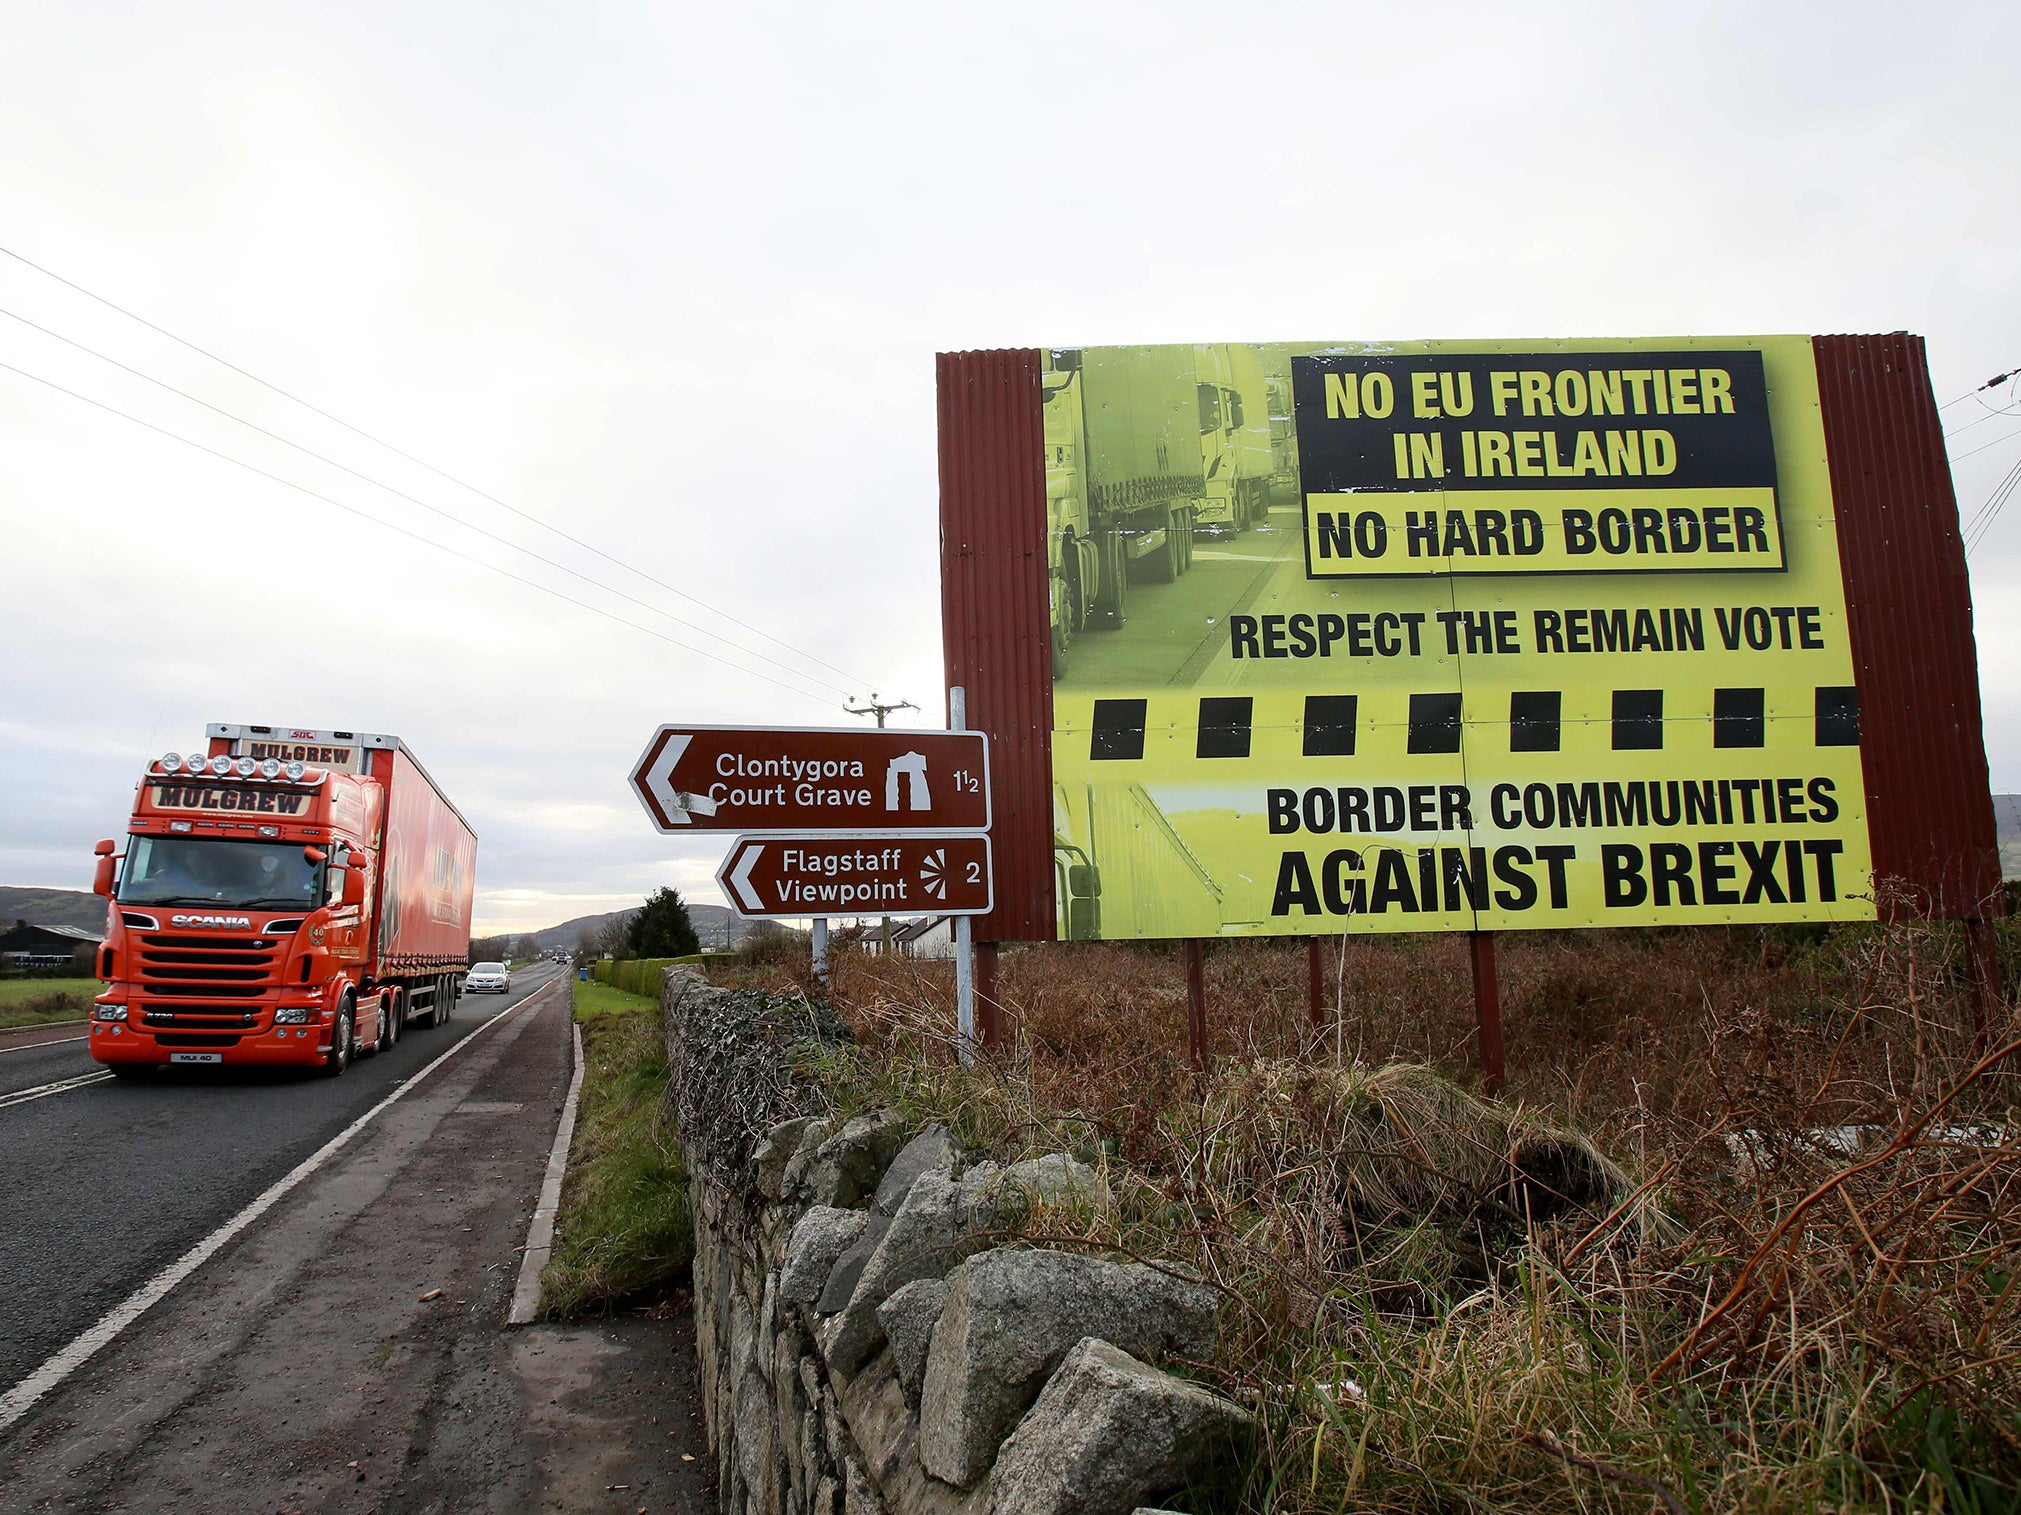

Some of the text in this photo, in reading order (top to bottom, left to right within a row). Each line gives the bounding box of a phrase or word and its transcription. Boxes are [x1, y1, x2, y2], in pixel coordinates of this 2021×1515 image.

[1324, 368, 1735, 420] NO EU FRONTIER
[1393, 429, 1678, 480] IN IRELAND
[1316, 506, 1770, 559] NO HARD BORDER
[1230, 606, 1825, 659] RESPECT THE REMAIN VOTE
[251, 742, 350, 764] MULGREW
[716, 752, 865, 782] Clontygora
[158, 786, 303, 815] MULGREW
[708, 782, 872, 806] Court Grave
[1266, 777, 1839, 836] BORDER COMMUNITIES
[782, 848, 902, 876] Flagstaff
[966, 861, 981, 884] 2
[775, 878, 907, 905] Viewpoint
[1270, 839, 1844, 917] AGAINST BREXIT
[171, 914, 252, 930] SCANIA
